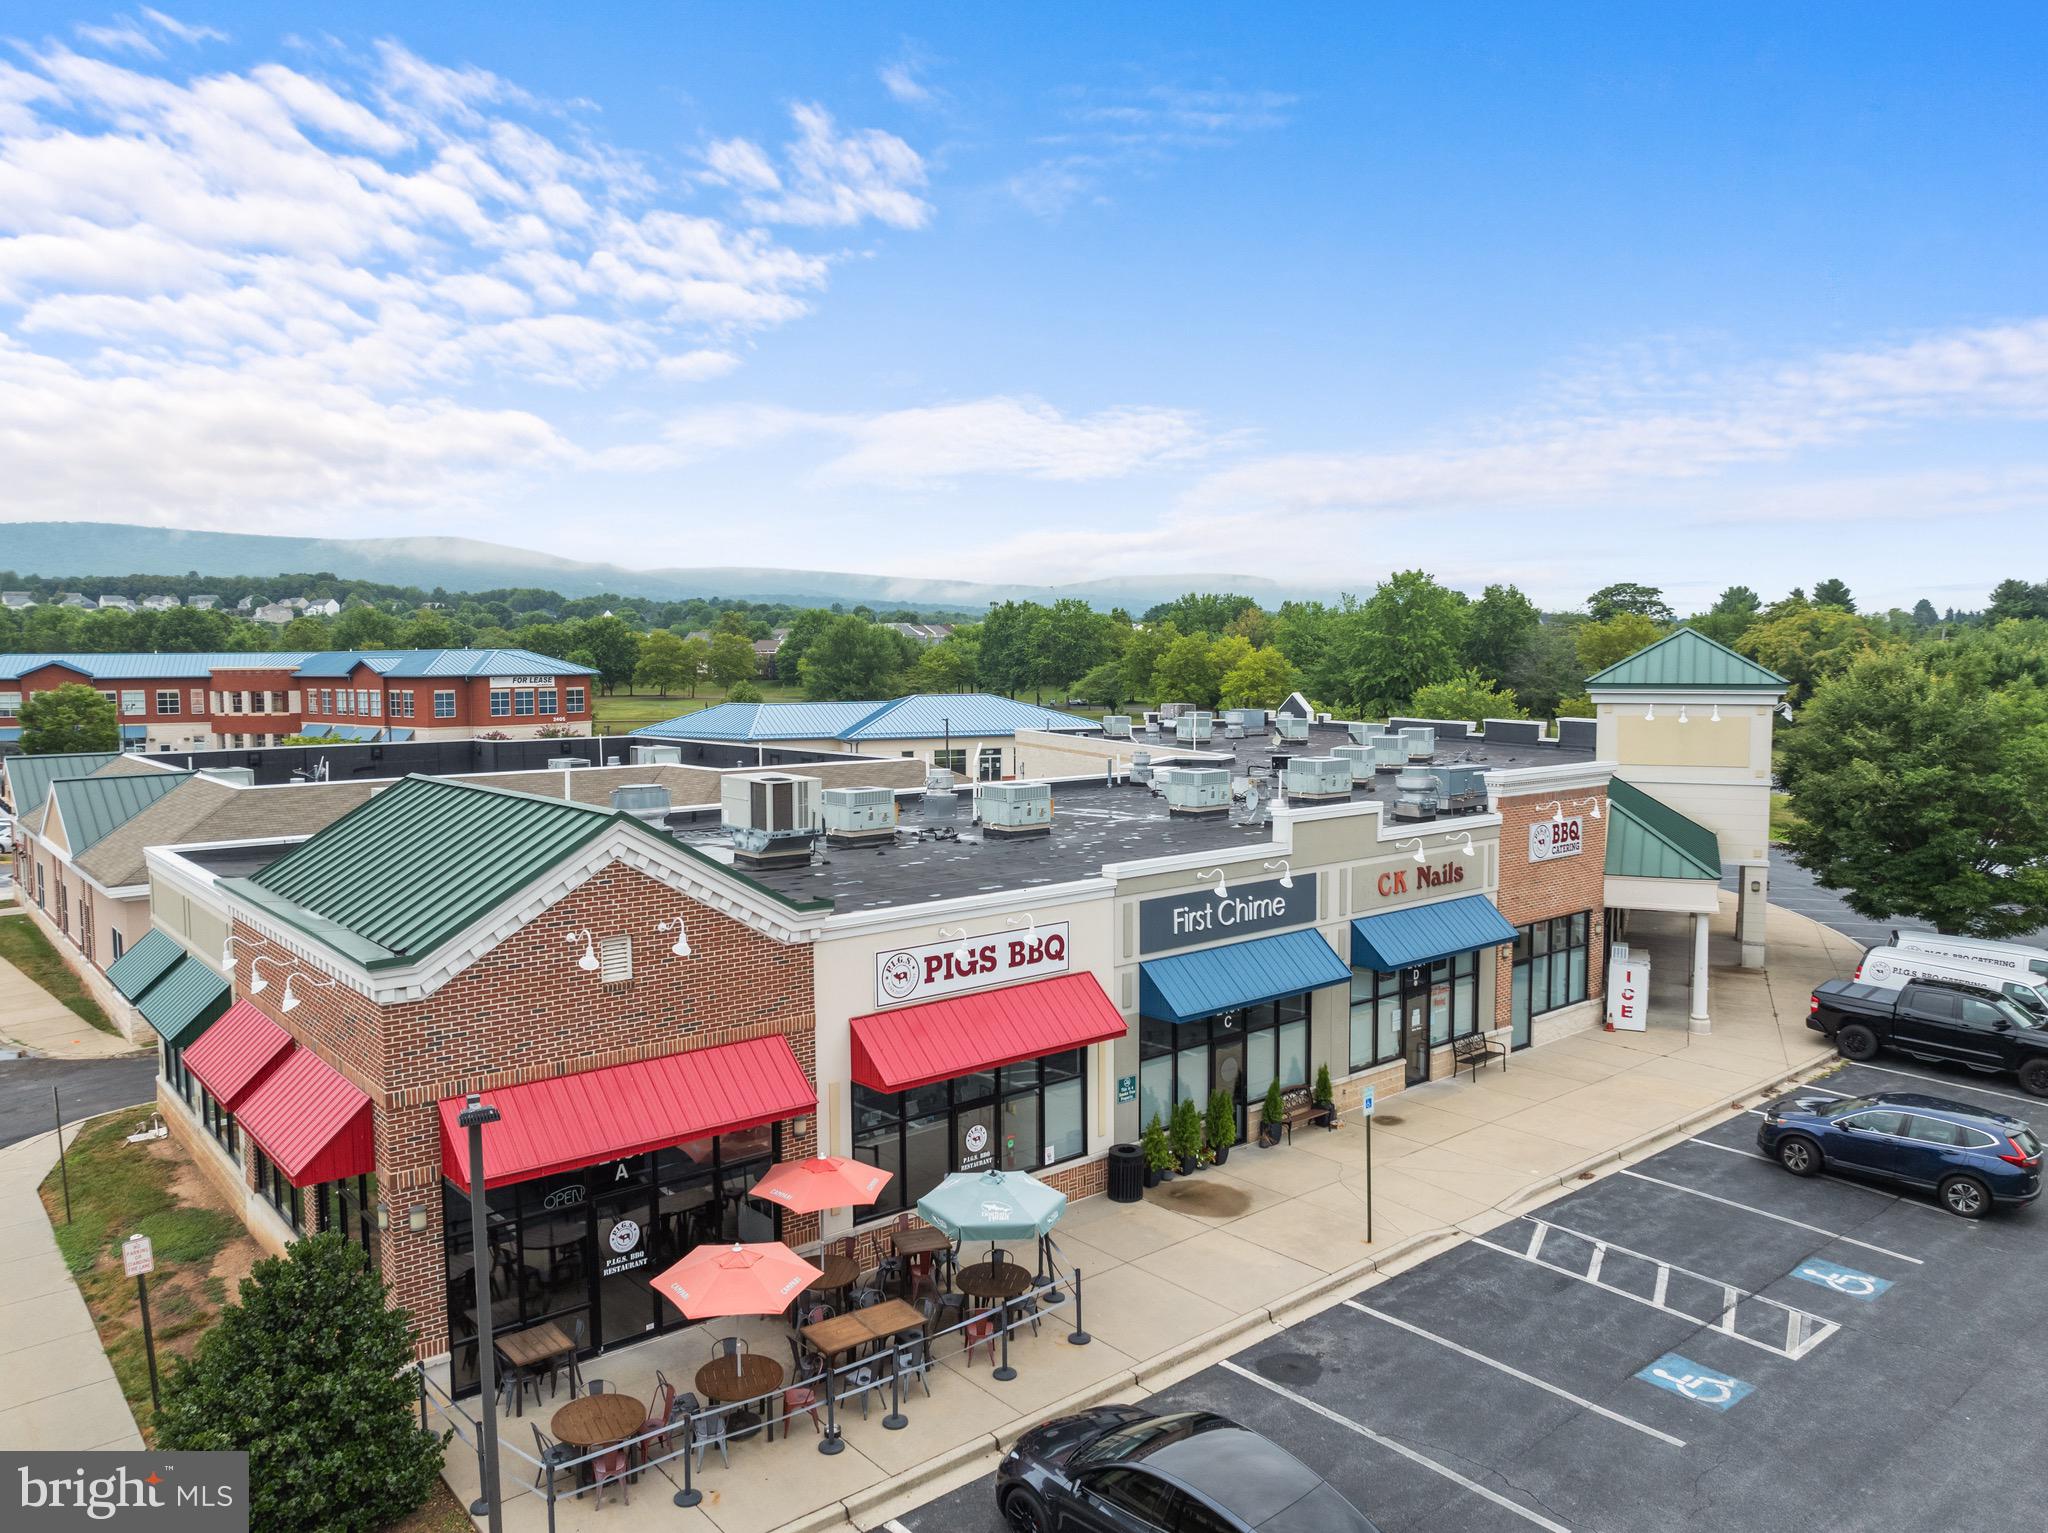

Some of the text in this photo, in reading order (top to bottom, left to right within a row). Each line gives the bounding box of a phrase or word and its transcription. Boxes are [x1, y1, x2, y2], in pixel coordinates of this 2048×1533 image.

[512, 676, 553, 684] FOR LEASE
[1552, 821, 1579, 844] BBQ
[1551, 842, 1580, 855] CATERING
[1378, 862, 1464, 897] CK Nails
[1173, 896, 1286, 934] First Chime
[924, 934, 1065, 984] PIGS BBQ
[1413, 969, 1420, 980] D
[1621, 971, 1635, 1019] ICE
[1224, 1015, 1232, 1028] C
[615, 1163, 629, 1181] A
[961, 1158, 993, 1171] RESTAURANT
[544, 1186, 585, 1210] OPEN
[630, 1250, 645, 1260] BBQ
[603, 1258, 648, 1276] RESTAURANT
